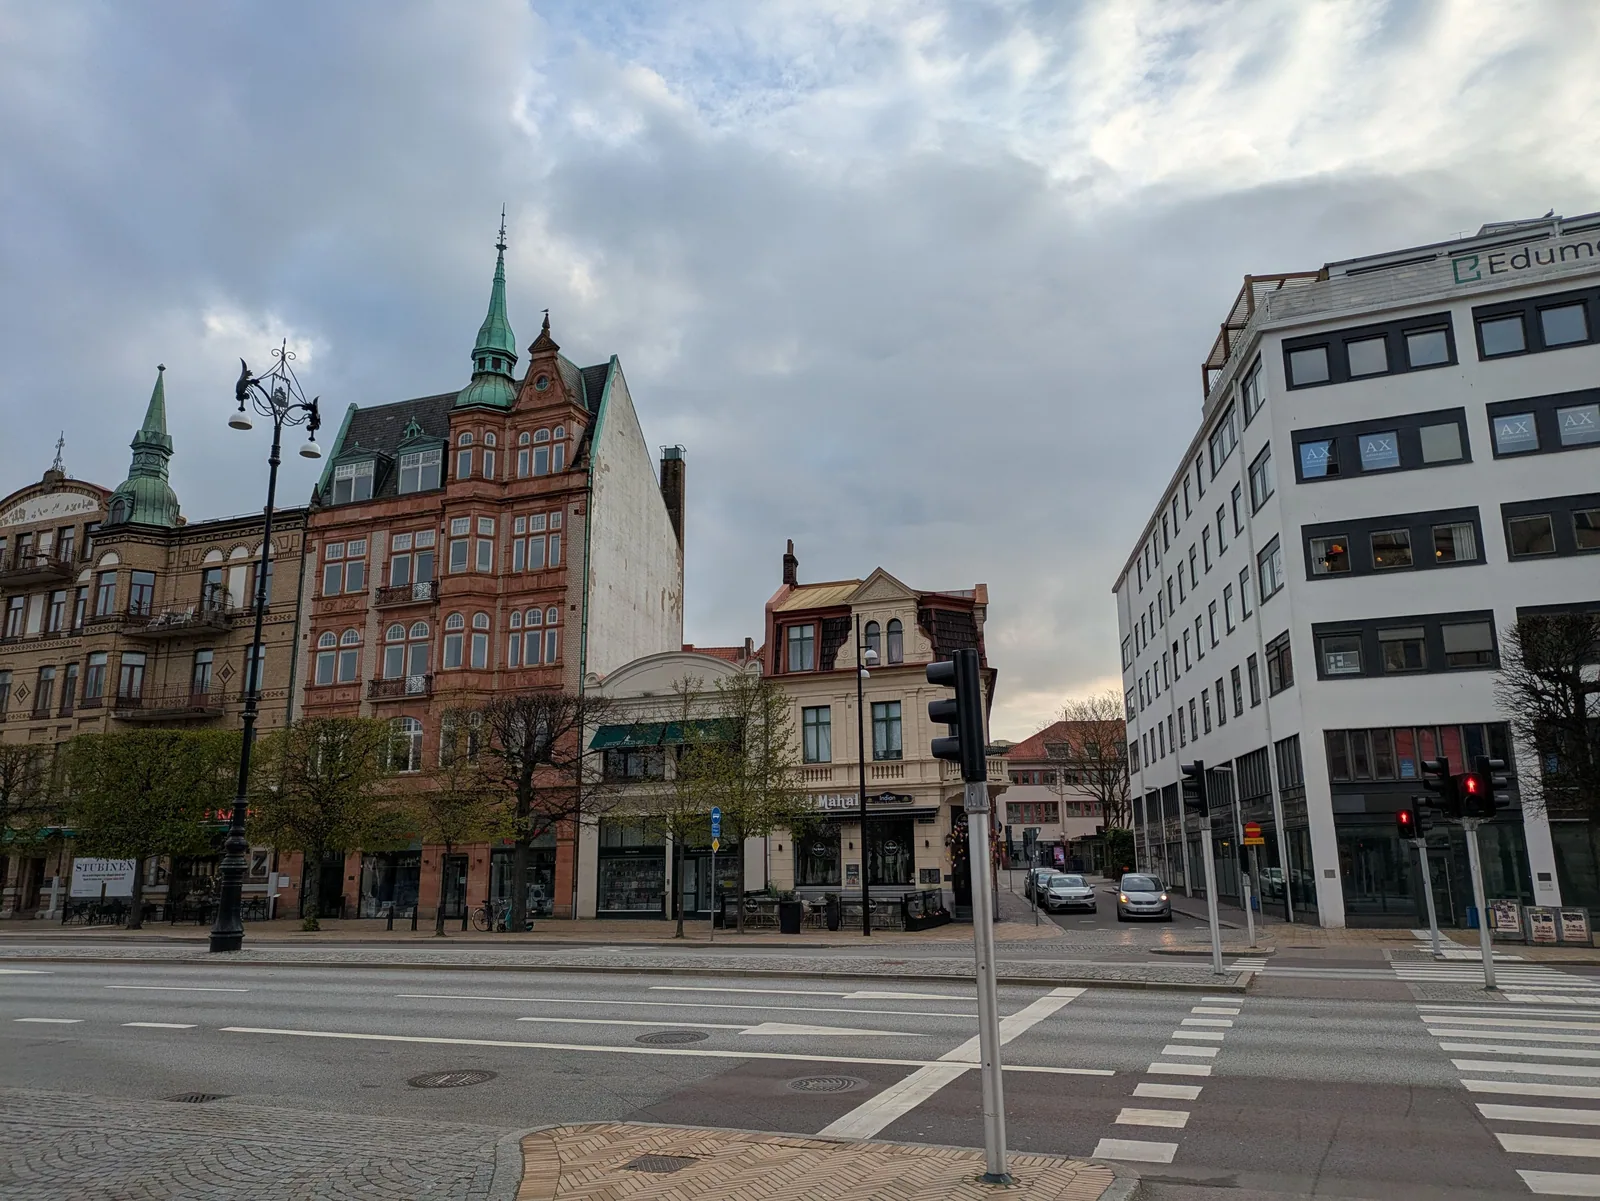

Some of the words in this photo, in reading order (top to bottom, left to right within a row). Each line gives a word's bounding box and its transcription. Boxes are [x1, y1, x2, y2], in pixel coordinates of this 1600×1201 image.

[1487, 240, 1600, 276] Edum
[1564, 412, 1596, 427] AX
[1501, 421, 1529, 436] AX
[1306, 445, 1332, 460] AX
[1365, 439, 1392, 454] AX
[818, 794, 859, 809] Mahal
[879, 793, 896, 801] Indian
